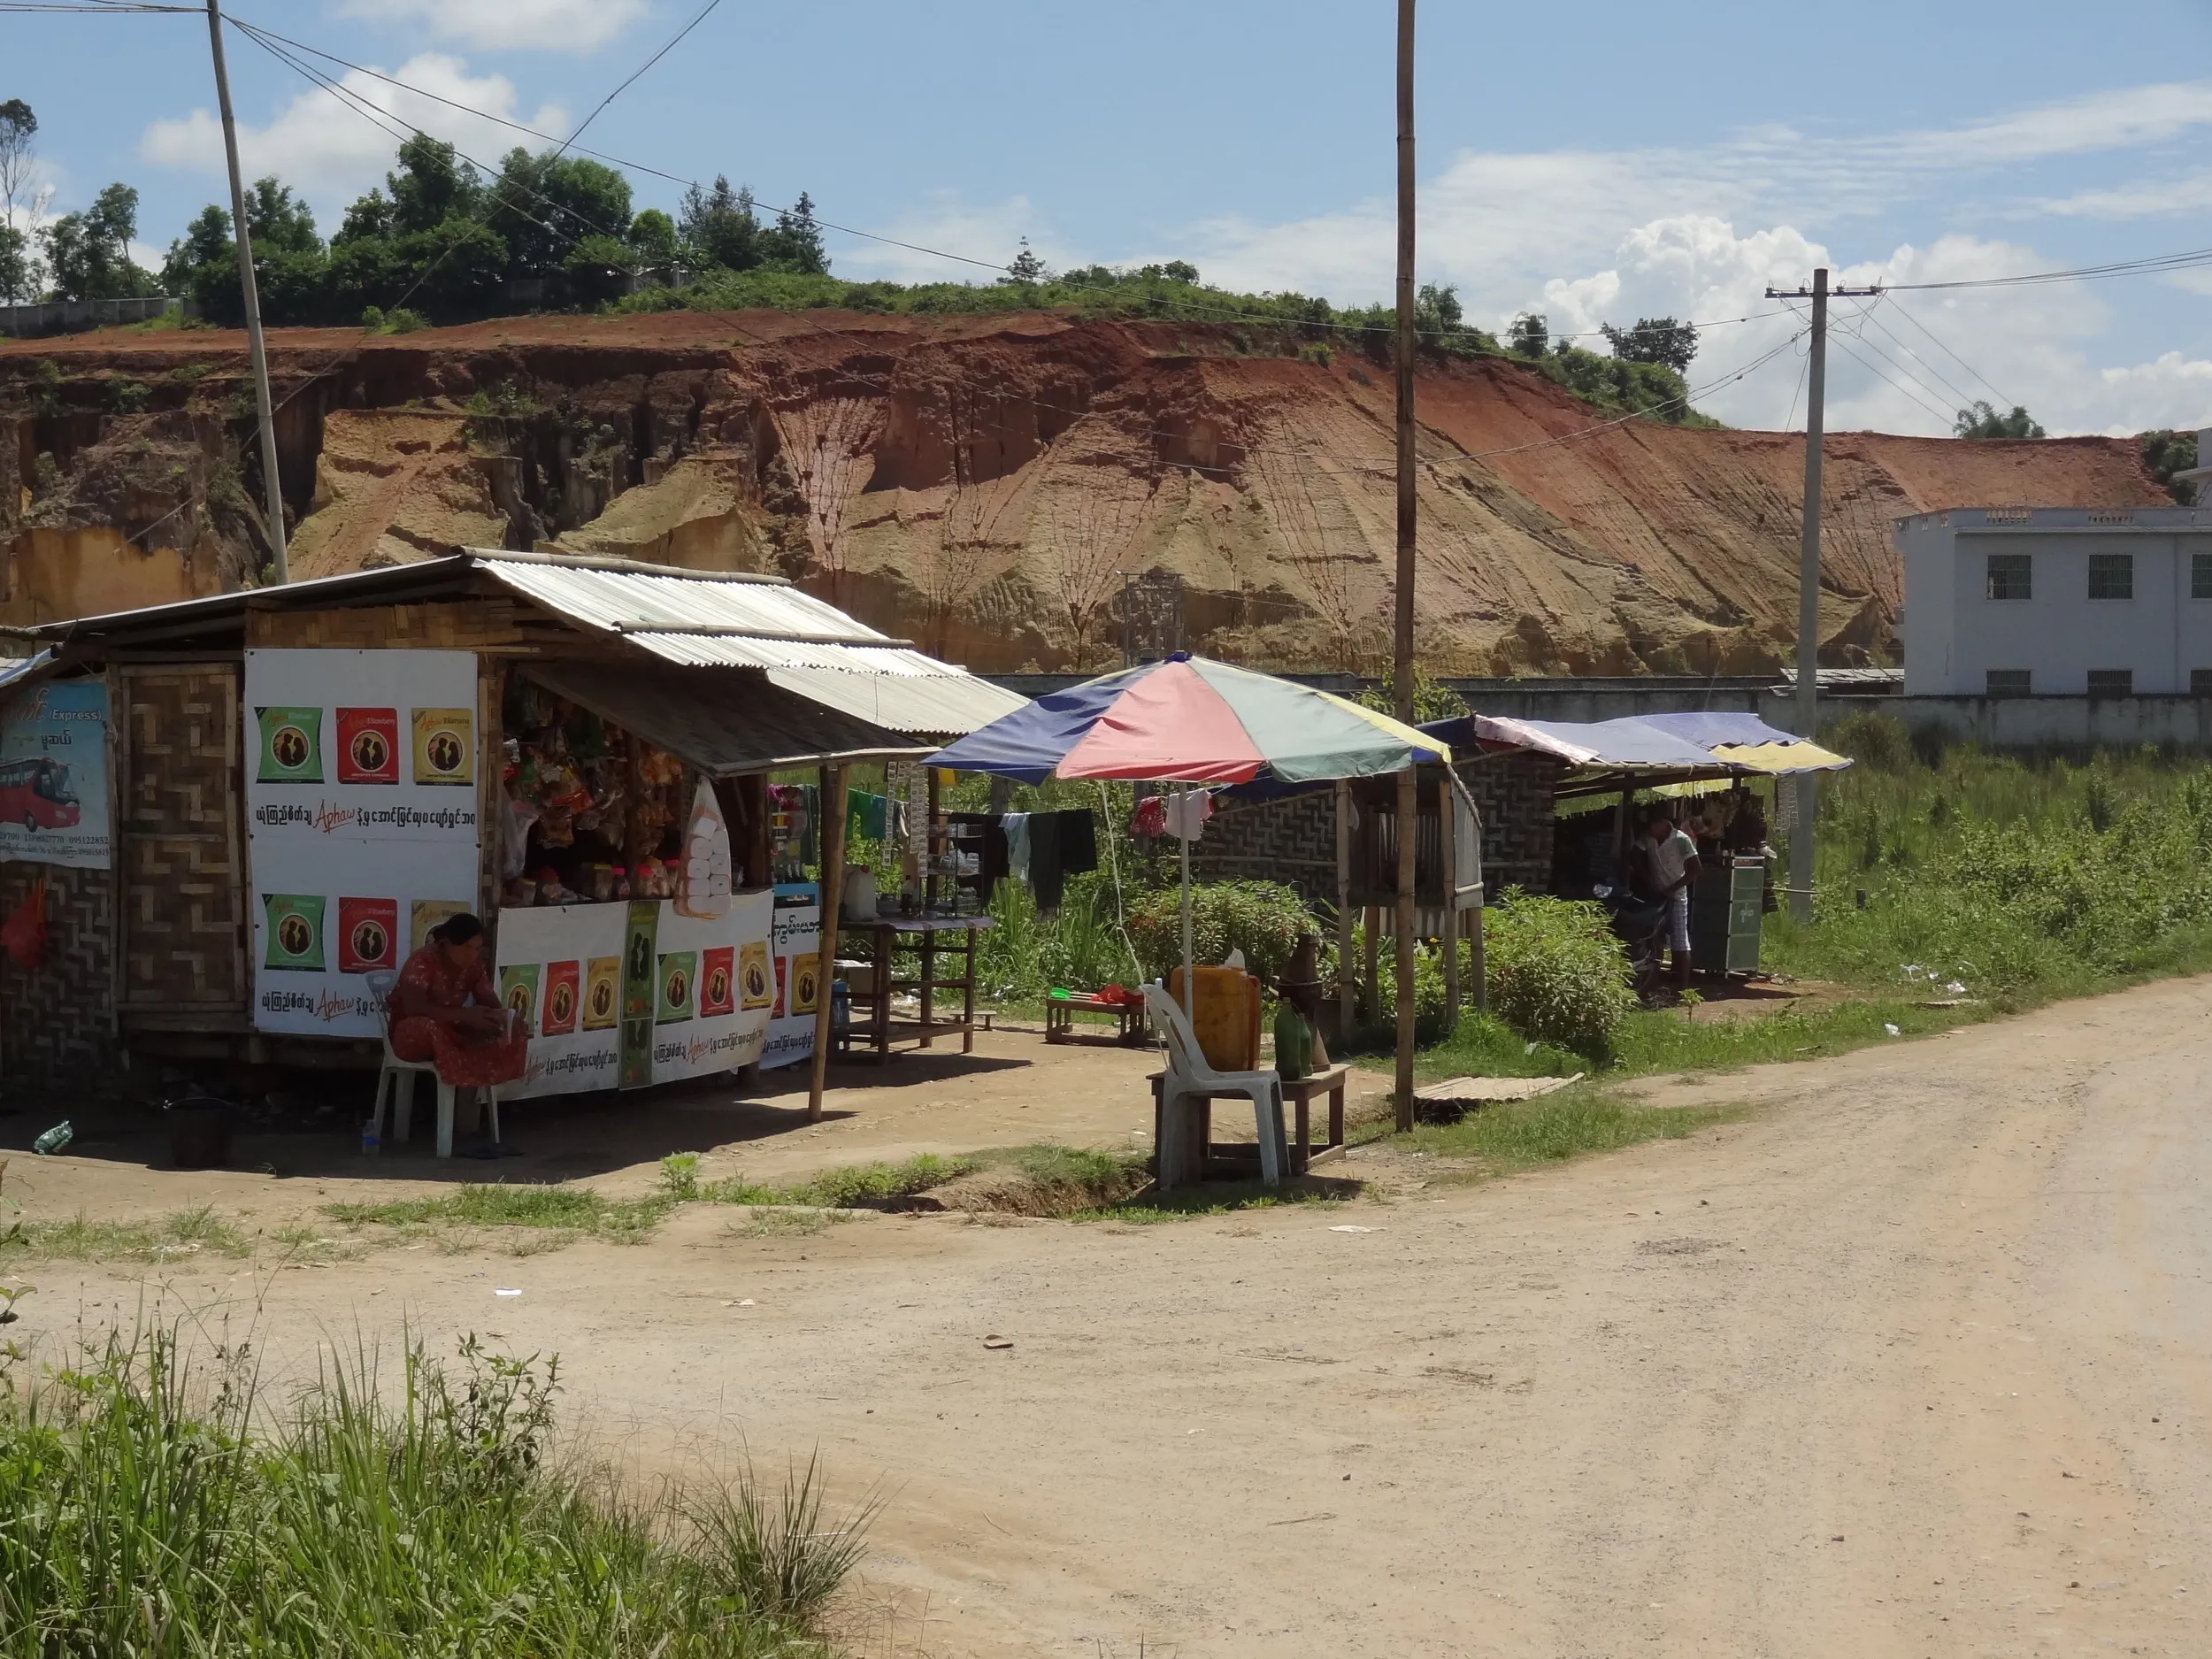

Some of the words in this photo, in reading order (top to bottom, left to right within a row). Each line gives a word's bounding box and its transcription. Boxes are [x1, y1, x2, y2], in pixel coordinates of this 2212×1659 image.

[50, 709, 102, 722] (Express)
[312, 798, 355, 834] Aphaw
[314, 987, 354, 1022] Aphaw
